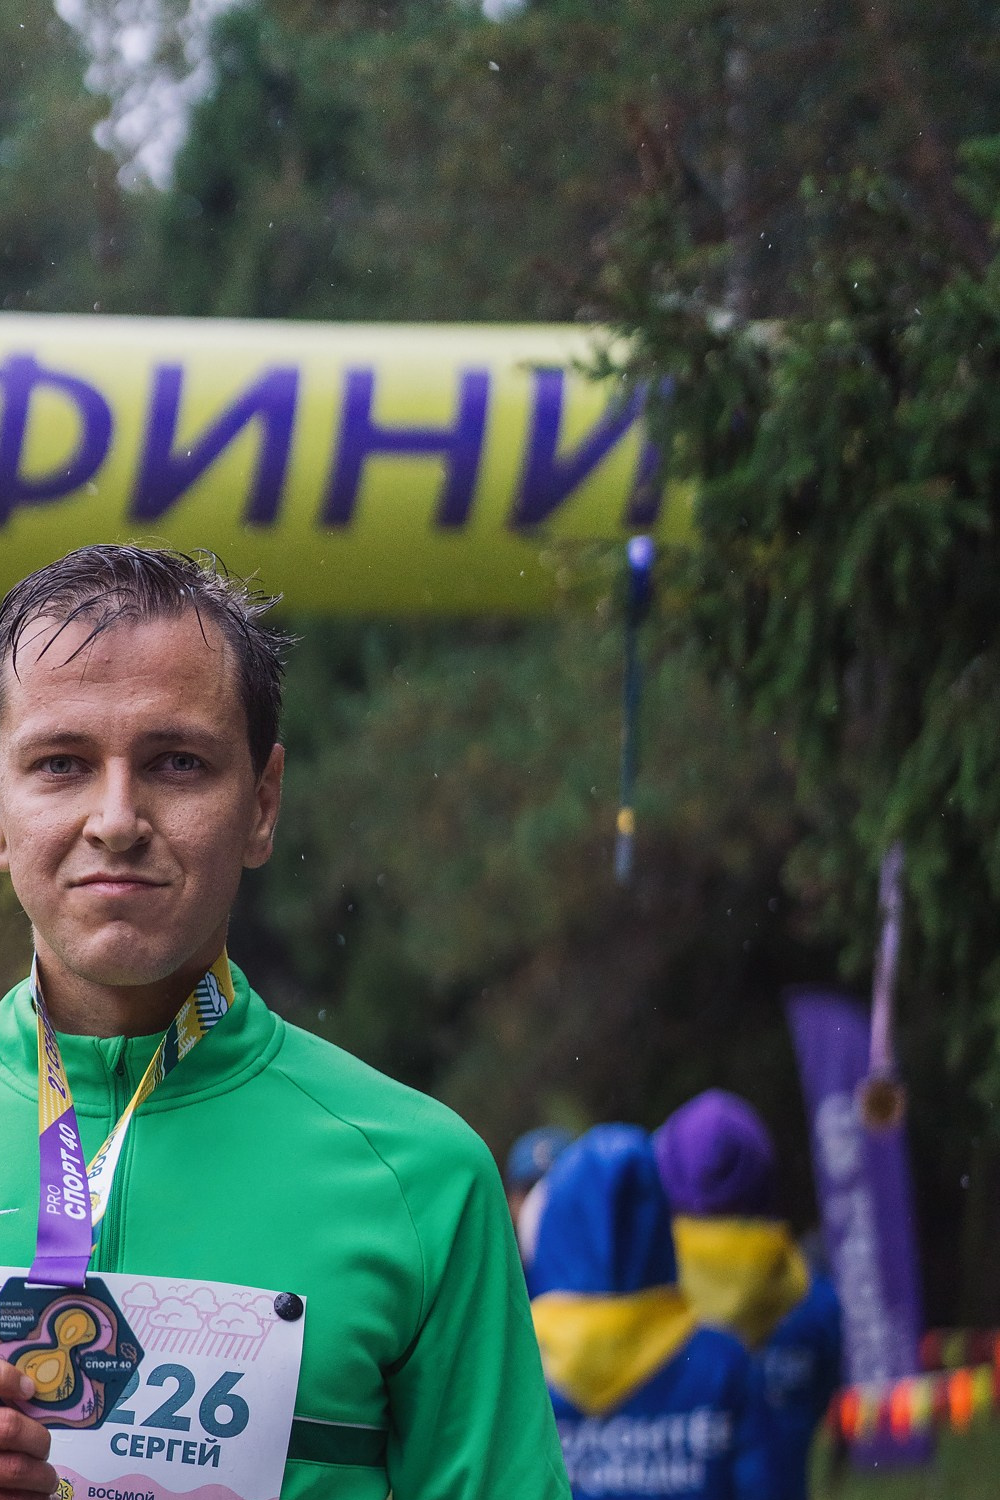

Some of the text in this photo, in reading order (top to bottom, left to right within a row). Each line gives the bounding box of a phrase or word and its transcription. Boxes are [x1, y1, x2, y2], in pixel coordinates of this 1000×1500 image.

[58, 1122, 87, 1220] СПОРТ 40
[46, 1184, 61, 1215] PRO
[0, 1321, 21, 1329] ТРЕЙЛ
[85, 1361, 132, 1369] СПОРТ 40
[110, 1432, 221, 1468] СЕРГЕЙ
